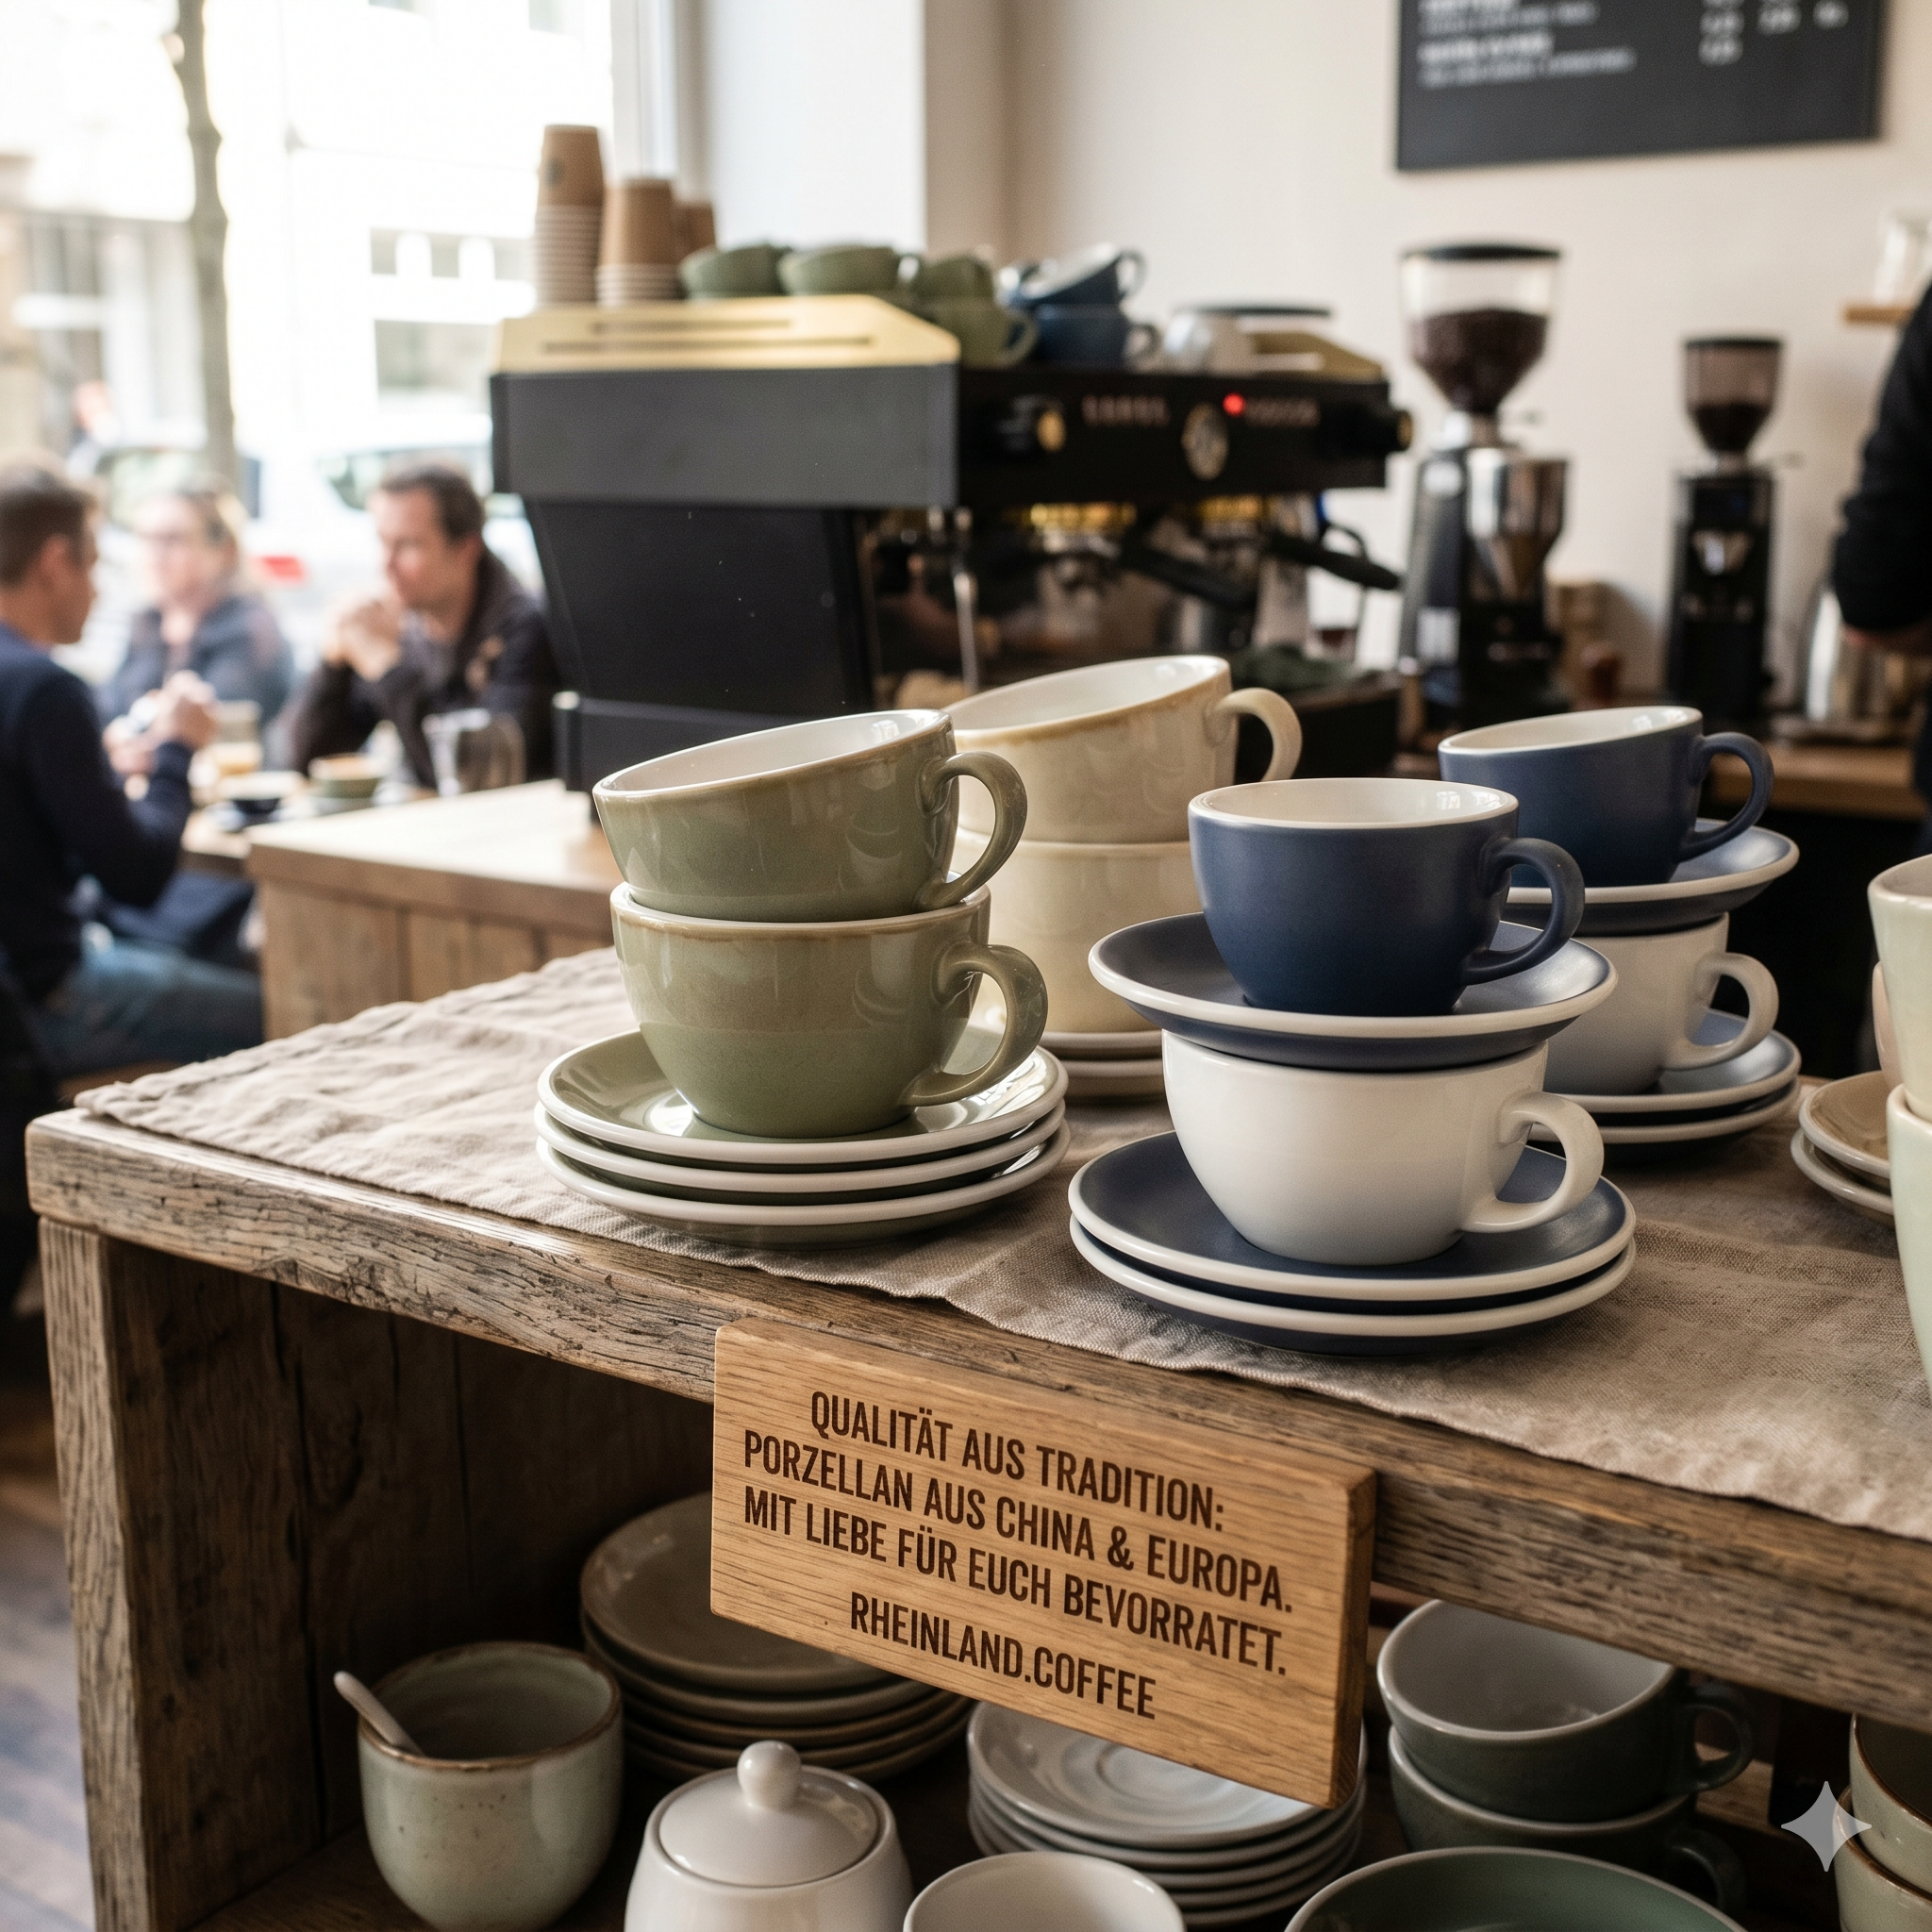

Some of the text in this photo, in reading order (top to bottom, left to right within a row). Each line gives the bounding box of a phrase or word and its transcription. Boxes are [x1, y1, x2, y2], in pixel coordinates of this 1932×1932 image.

[744, 1430, 1291, 1612] PORZELLAN AUS CHINA & EUROPA.
[811, 1391, 1224, 1531] QUALITÄT AUS TRADITION:
[744, 1486, 1286, 1675] MIT LIEBE FÜR EUCH BEVORRATET.
[851, 1591, 1156, 1719] RHEINLAND.COFFEE
